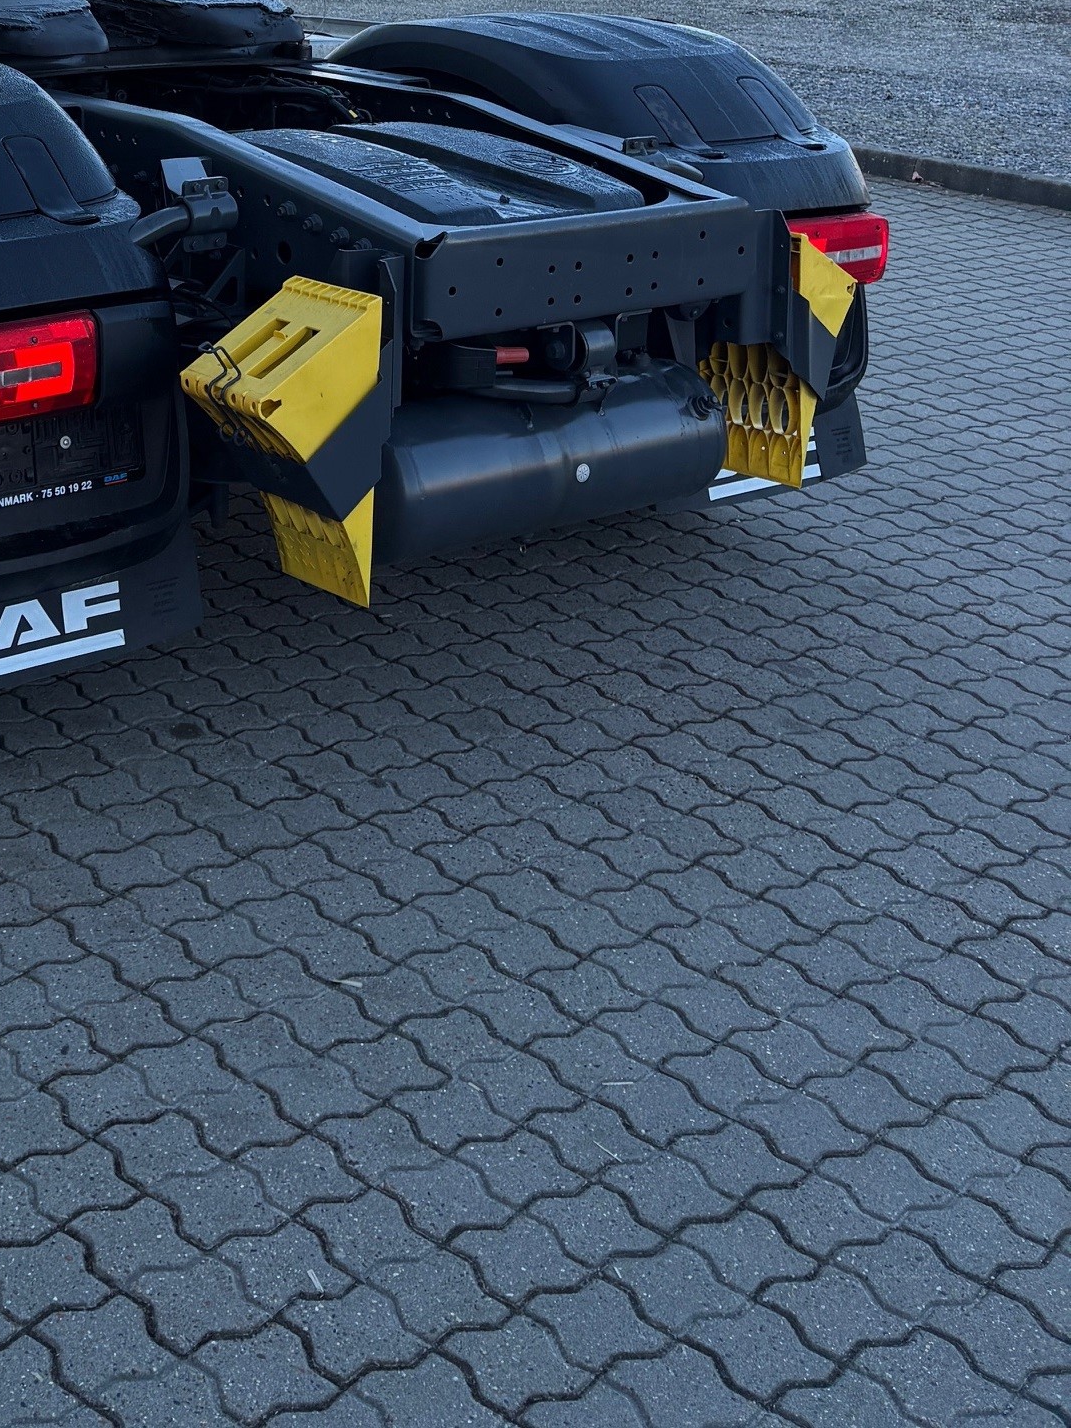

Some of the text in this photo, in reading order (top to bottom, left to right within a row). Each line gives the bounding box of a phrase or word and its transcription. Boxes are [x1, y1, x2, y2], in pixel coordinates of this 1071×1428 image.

[104, 472, 128, 483] DAF
[41, 489, 53, 499] 75
[54, 486, 66, 497] 50
[68, 483, 79, 494] 19
[81, 480, 93, 491] 22
